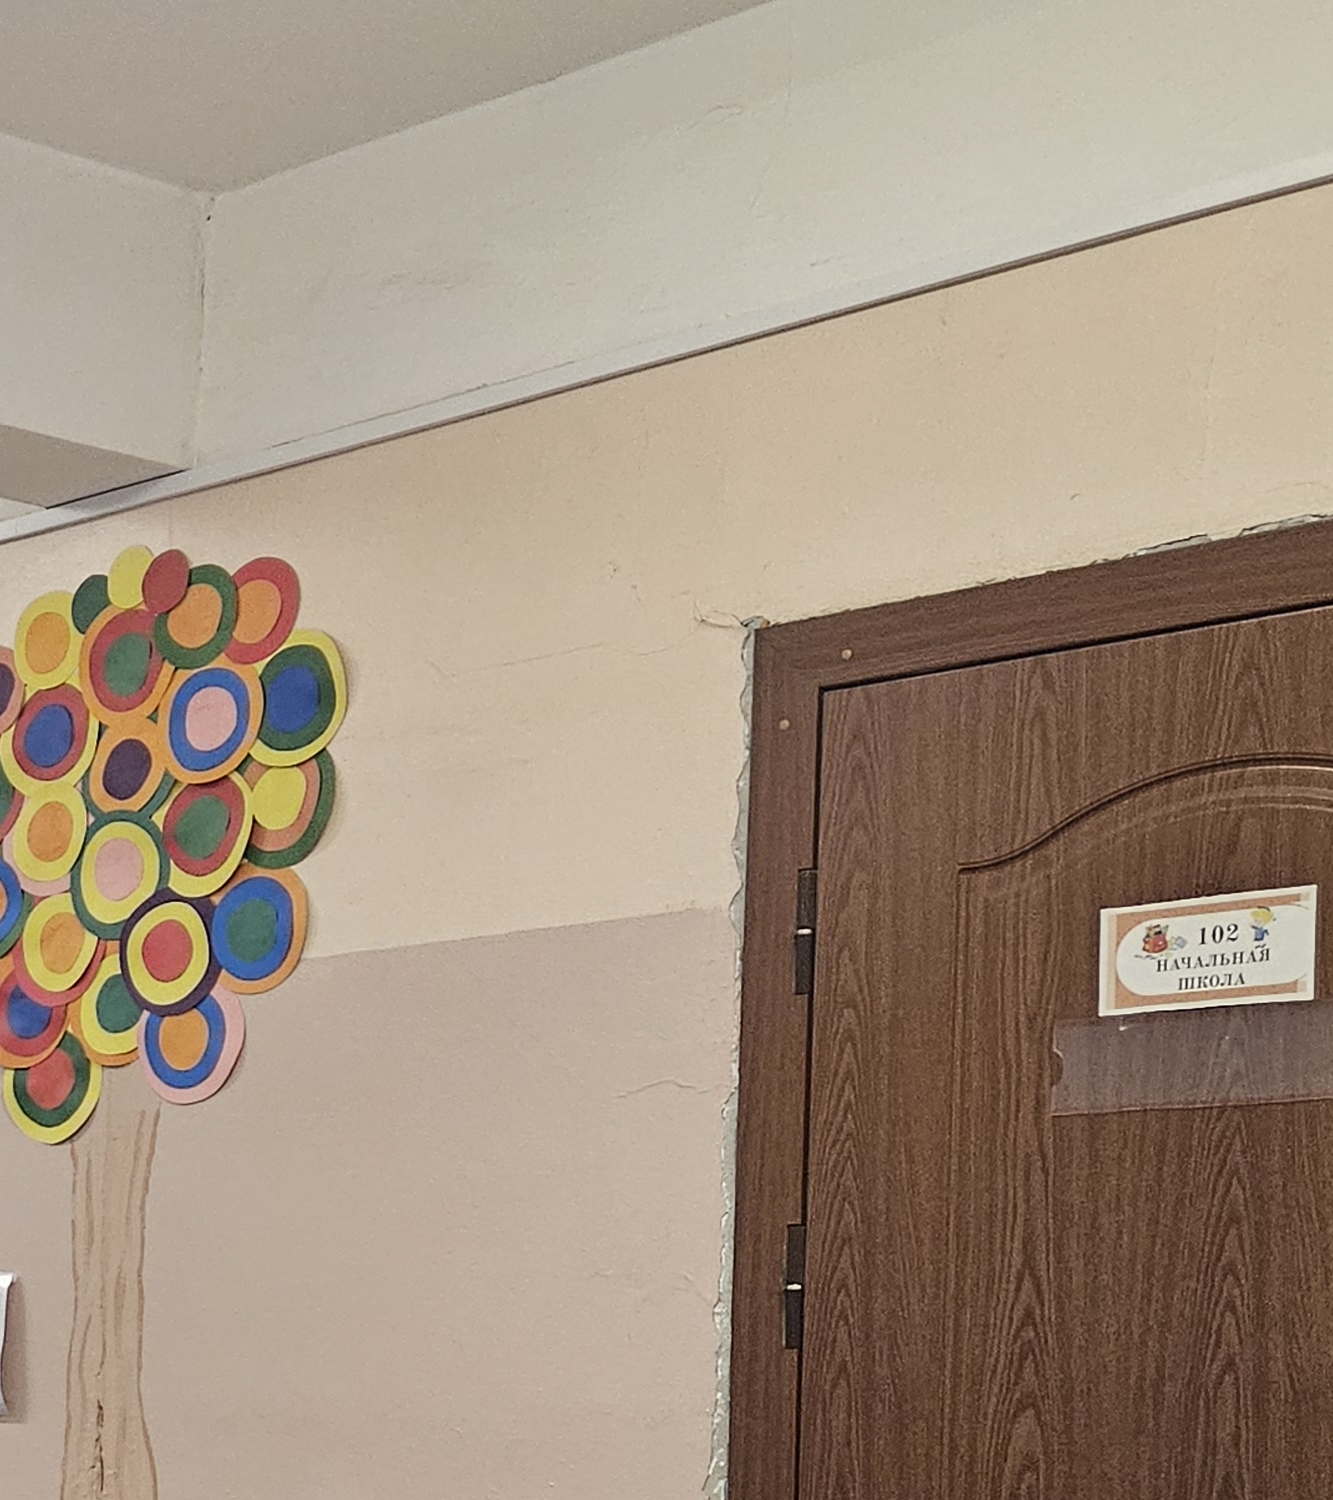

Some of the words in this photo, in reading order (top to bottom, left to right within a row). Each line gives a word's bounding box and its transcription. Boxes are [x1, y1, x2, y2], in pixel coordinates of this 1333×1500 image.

[1198, 923, 1239, 946] 102
[1156, 948, 1270, 972] НАЧАЛЬНАЯ
[1178, 973, 1245, 991] ШКОЛА
